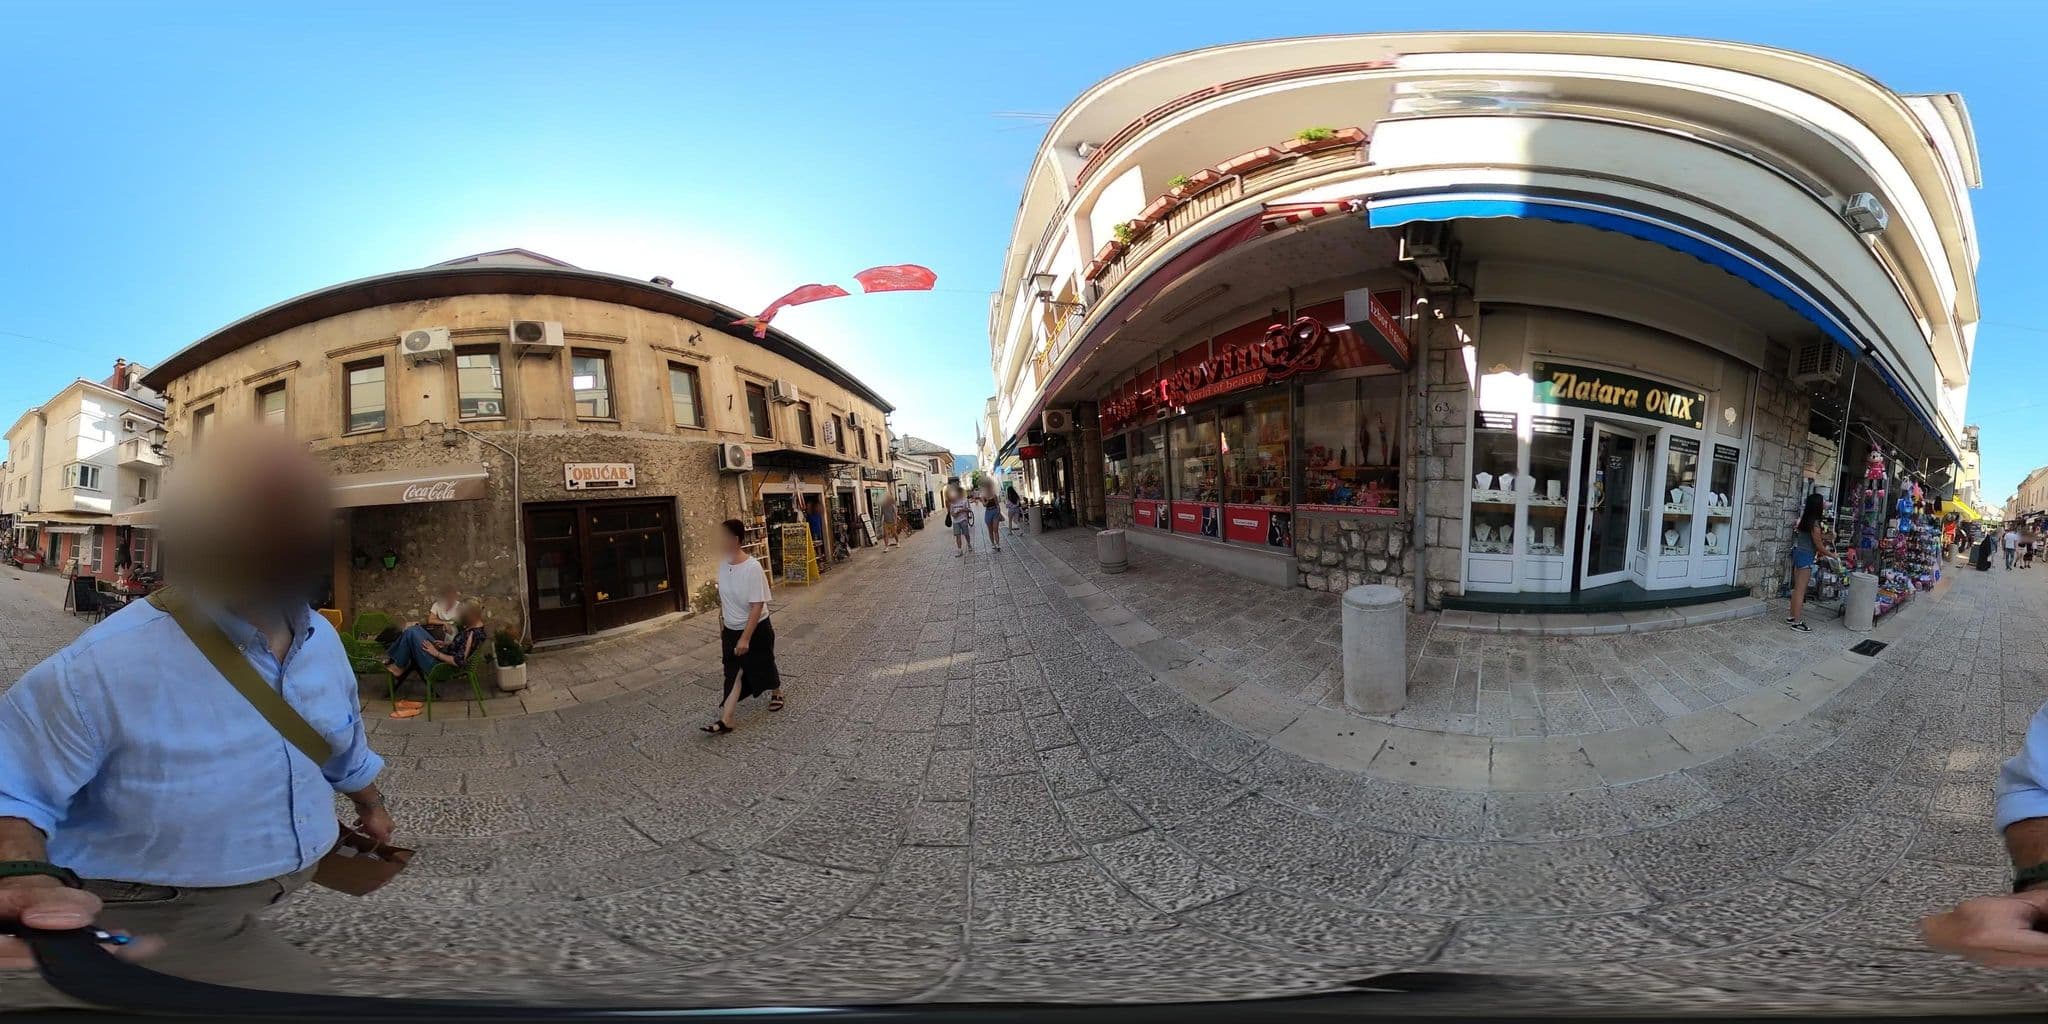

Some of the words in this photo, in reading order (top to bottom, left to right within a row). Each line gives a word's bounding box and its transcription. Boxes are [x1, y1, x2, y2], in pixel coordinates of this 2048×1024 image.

[1226, 374, 1265, 389] beauty
[1549, 370, 1639, 408] Zlatara
[1645, 389, 1695, 421] ONIX
[572, 465, 628, 480] OBUĆAR
[402, 481, 457, 503] Coca-Cola
